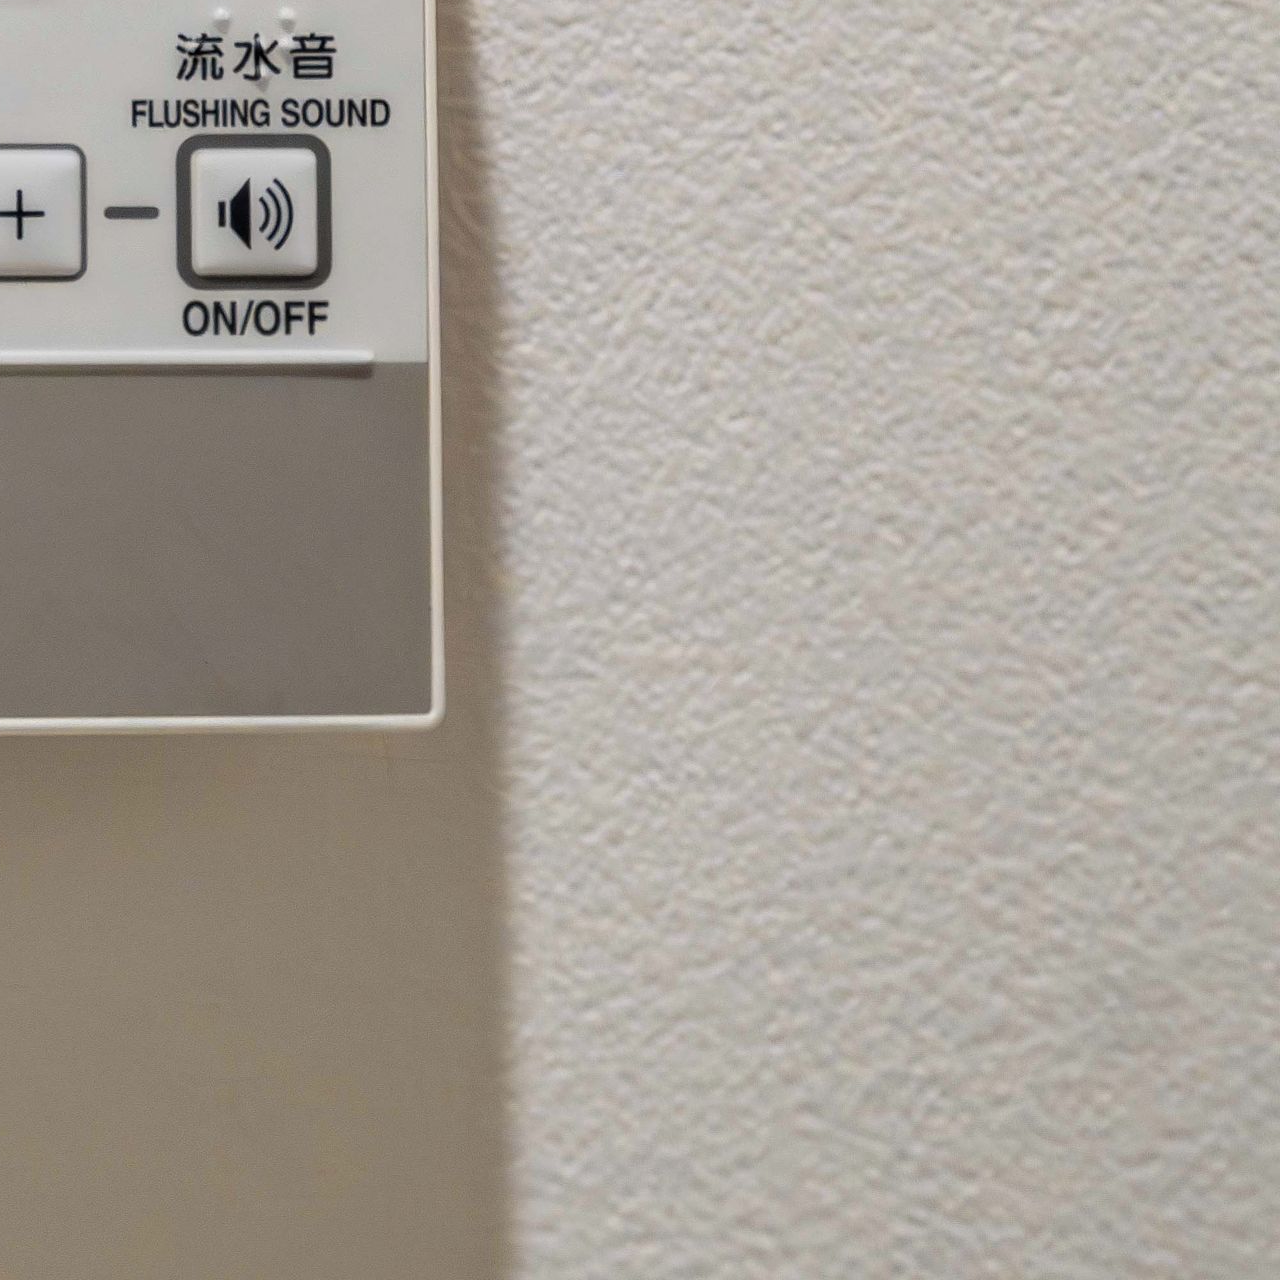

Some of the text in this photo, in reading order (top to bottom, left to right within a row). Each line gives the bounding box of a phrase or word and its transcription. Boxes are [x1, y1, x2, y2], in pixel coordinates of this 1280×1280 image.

[176, 32, 337, 82] 流水音
[131, 98, 391, 129] FLUSHING SOUND
[182, 300, 329, 337] ON/OFF
